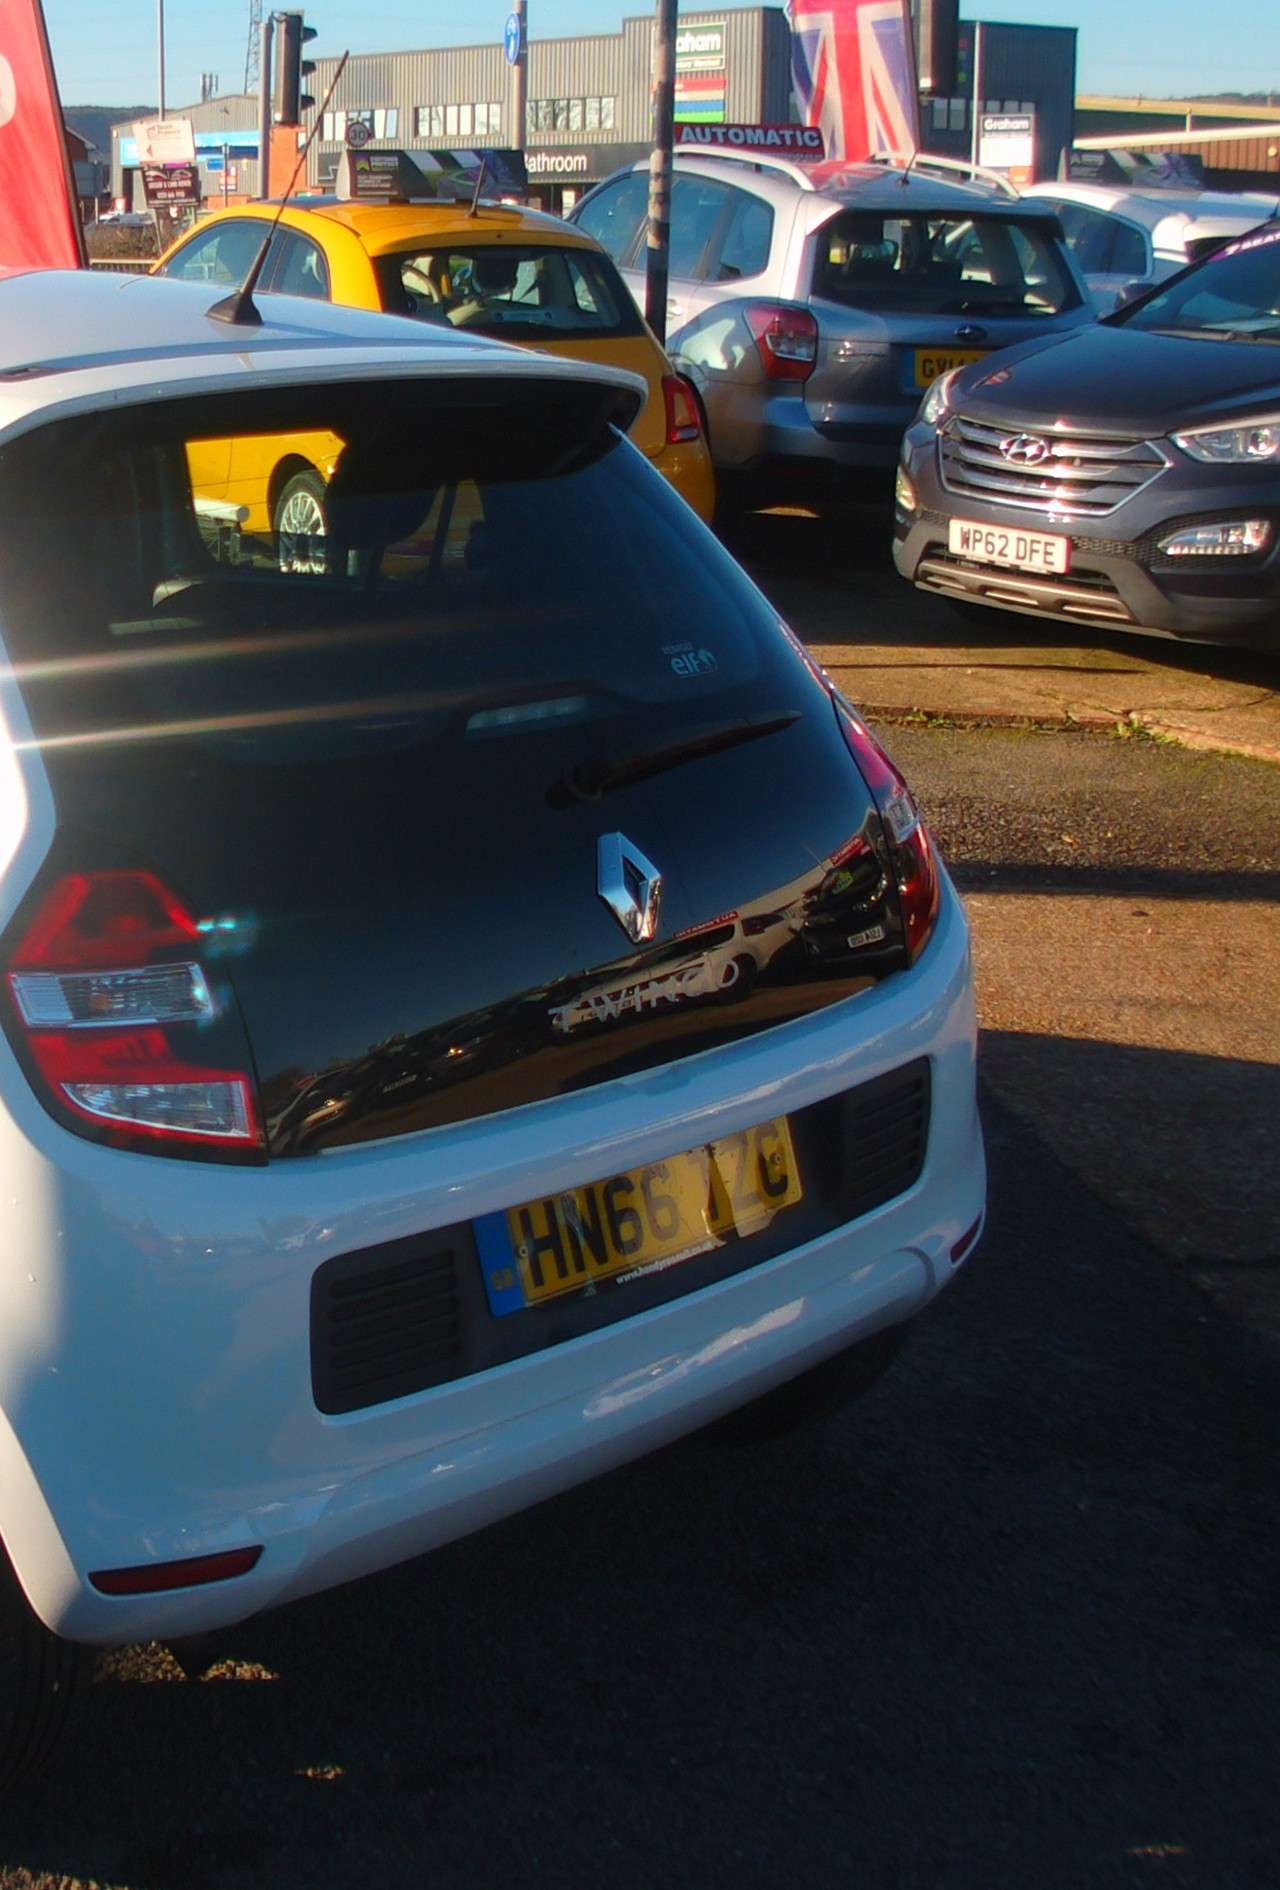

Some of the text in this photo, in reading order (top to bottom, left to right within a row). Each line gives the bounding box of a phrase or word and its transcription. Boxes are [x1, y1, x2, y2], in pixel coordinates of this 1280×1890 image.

[675, 31, 721, 53] aham
[680, 126, 820, 147] AUTOMATIC
[983, 118, 1029, 130] Graham
[959, 526, 1056, 566] WP62 DFE
[548, 958, 739, 1034] TWINGO
[517, 1166, 680, 1288] HN66
